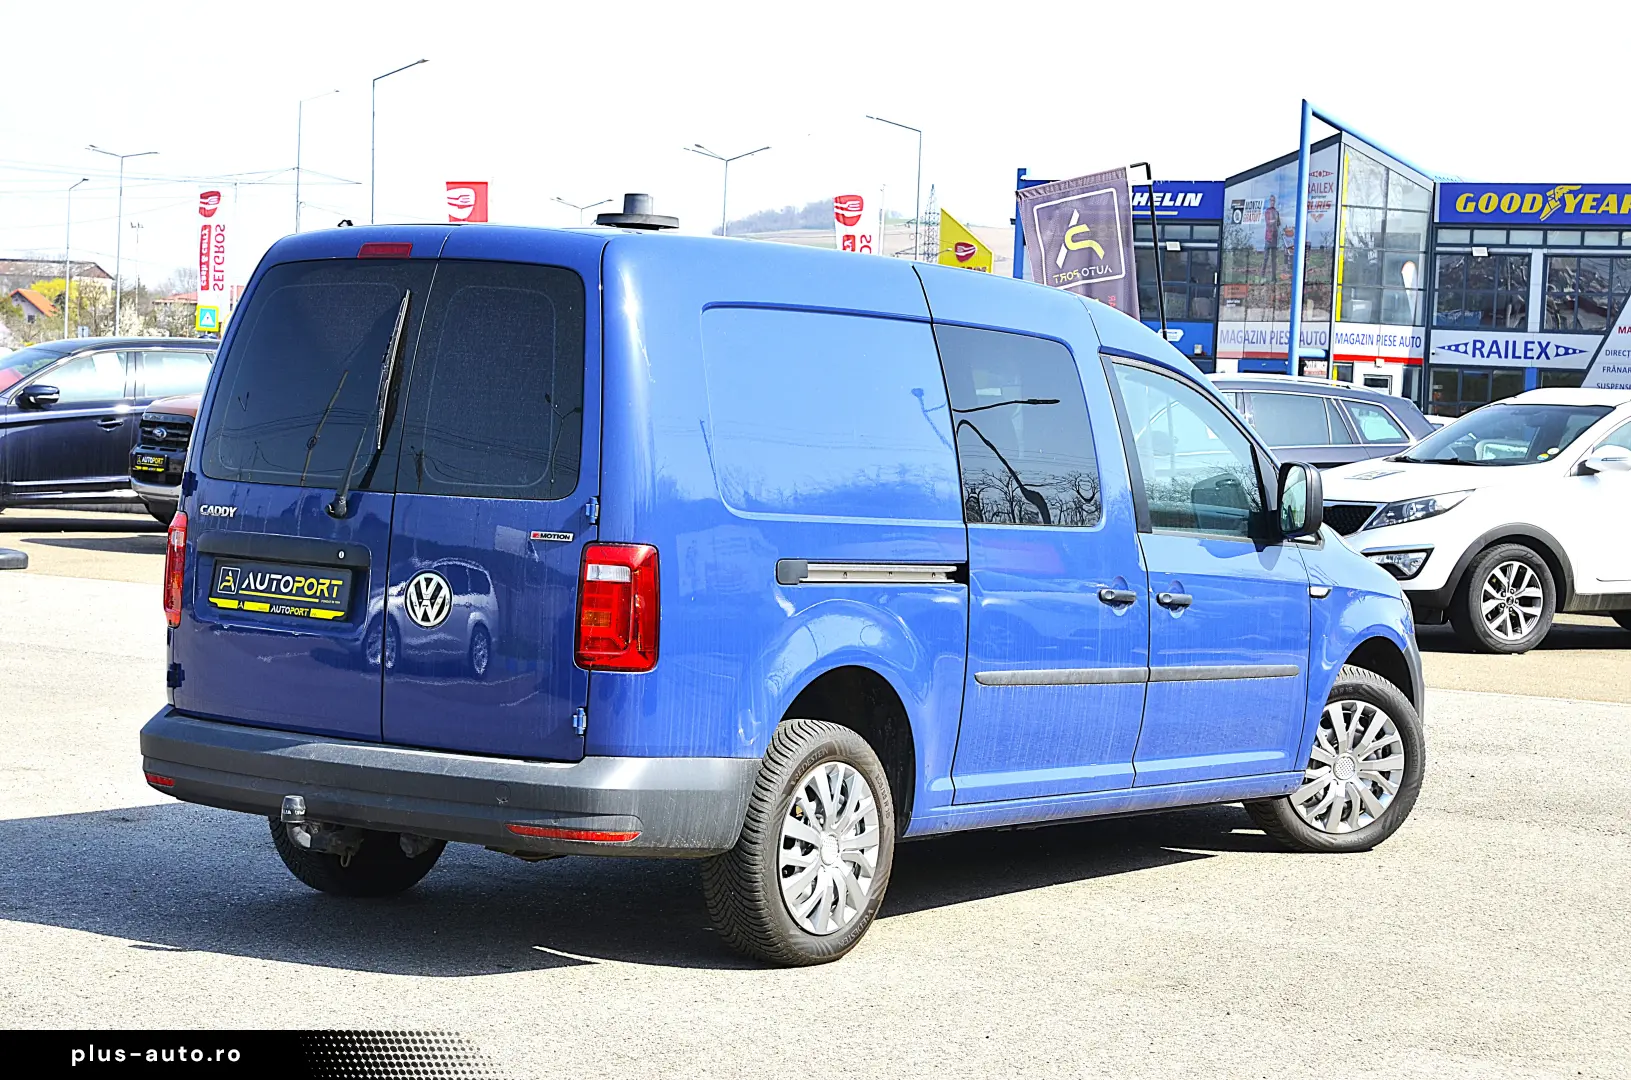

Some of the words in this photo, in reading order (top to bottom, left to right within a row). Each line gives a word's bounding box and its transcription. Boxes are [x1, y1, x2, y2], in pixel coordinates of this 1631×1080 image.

[1131, 192, 1203, 207] HELIN
[1220, 329, 1267, 345] MAGAZIN
[1269, 330, 1290, 346] PIES
[1300, 331, 1327, 346] AUTO
[1334, 332, 1374, 346] MAGAZIN
[1375, 334, 1397, 347] PIESE
[1398, 335, 1422, 348] AUTO
[1472, 338, 1552, 361] RAILEX
[200, 504, 237, 518] CADDY
[241, 571, 343, 598] AUTOPORT
[270, 604, 309, 617] AUTOPORT
